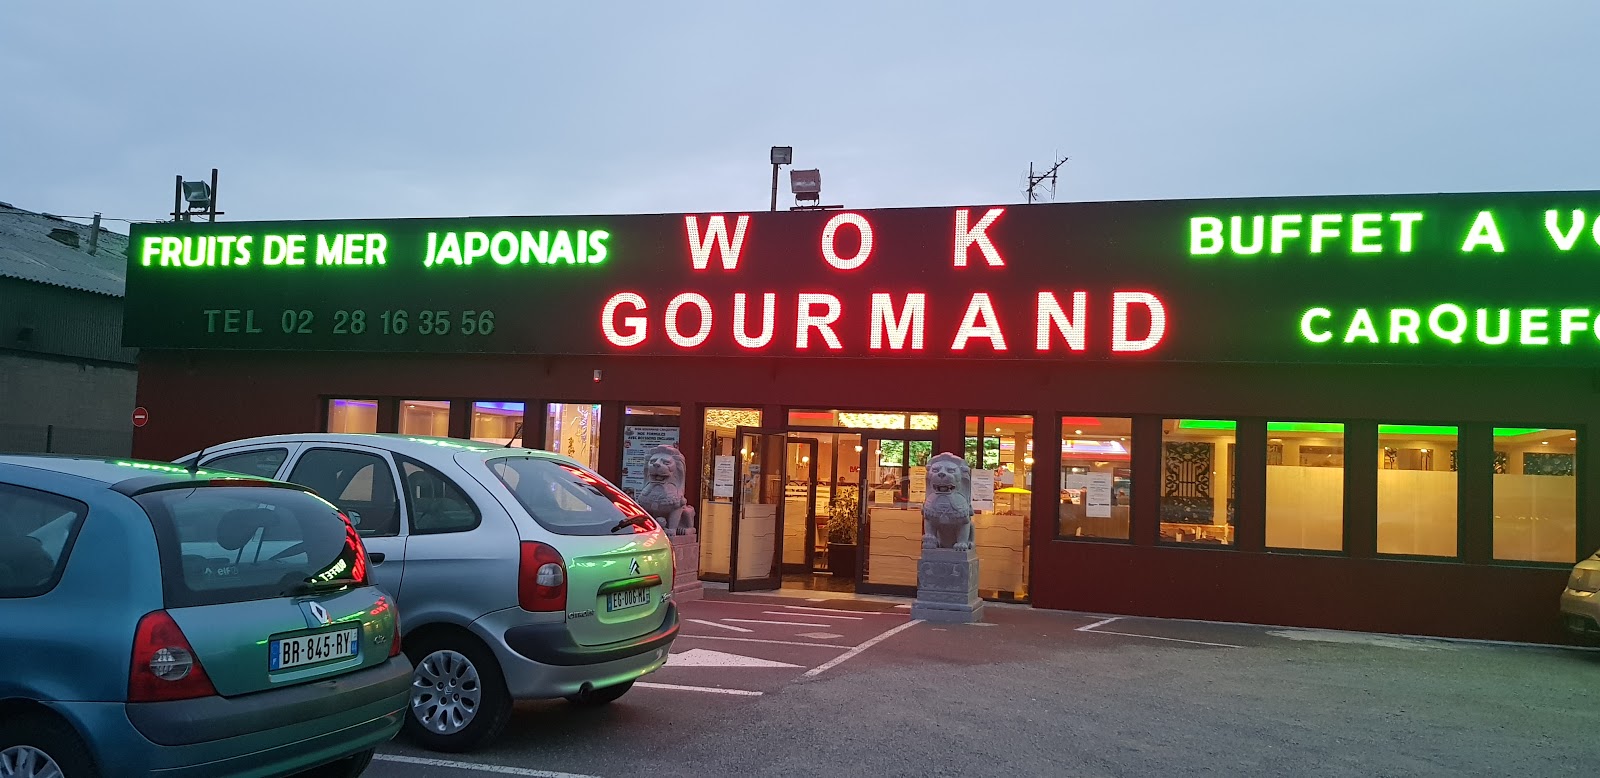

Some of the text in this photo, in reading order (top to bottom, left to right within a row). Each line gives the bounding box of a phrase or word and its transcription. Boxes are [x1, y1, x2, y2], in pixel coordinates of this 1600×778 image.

[141, 233, 387, 267] FRUITS DE MER
[424, 229, 610, 267] JAPONAIS
[1190, 212, 1423, 255] BUFFET
[1462, 210, 1505, 252] A
[204, 309, 495, 335] TEL 02 28 16 35 56
[601, 291, 1167, 352] GOURMAND
[1300, 302, 1600, 345] CARQUEF
[282, 631, 351, 665] BR-845-RY
